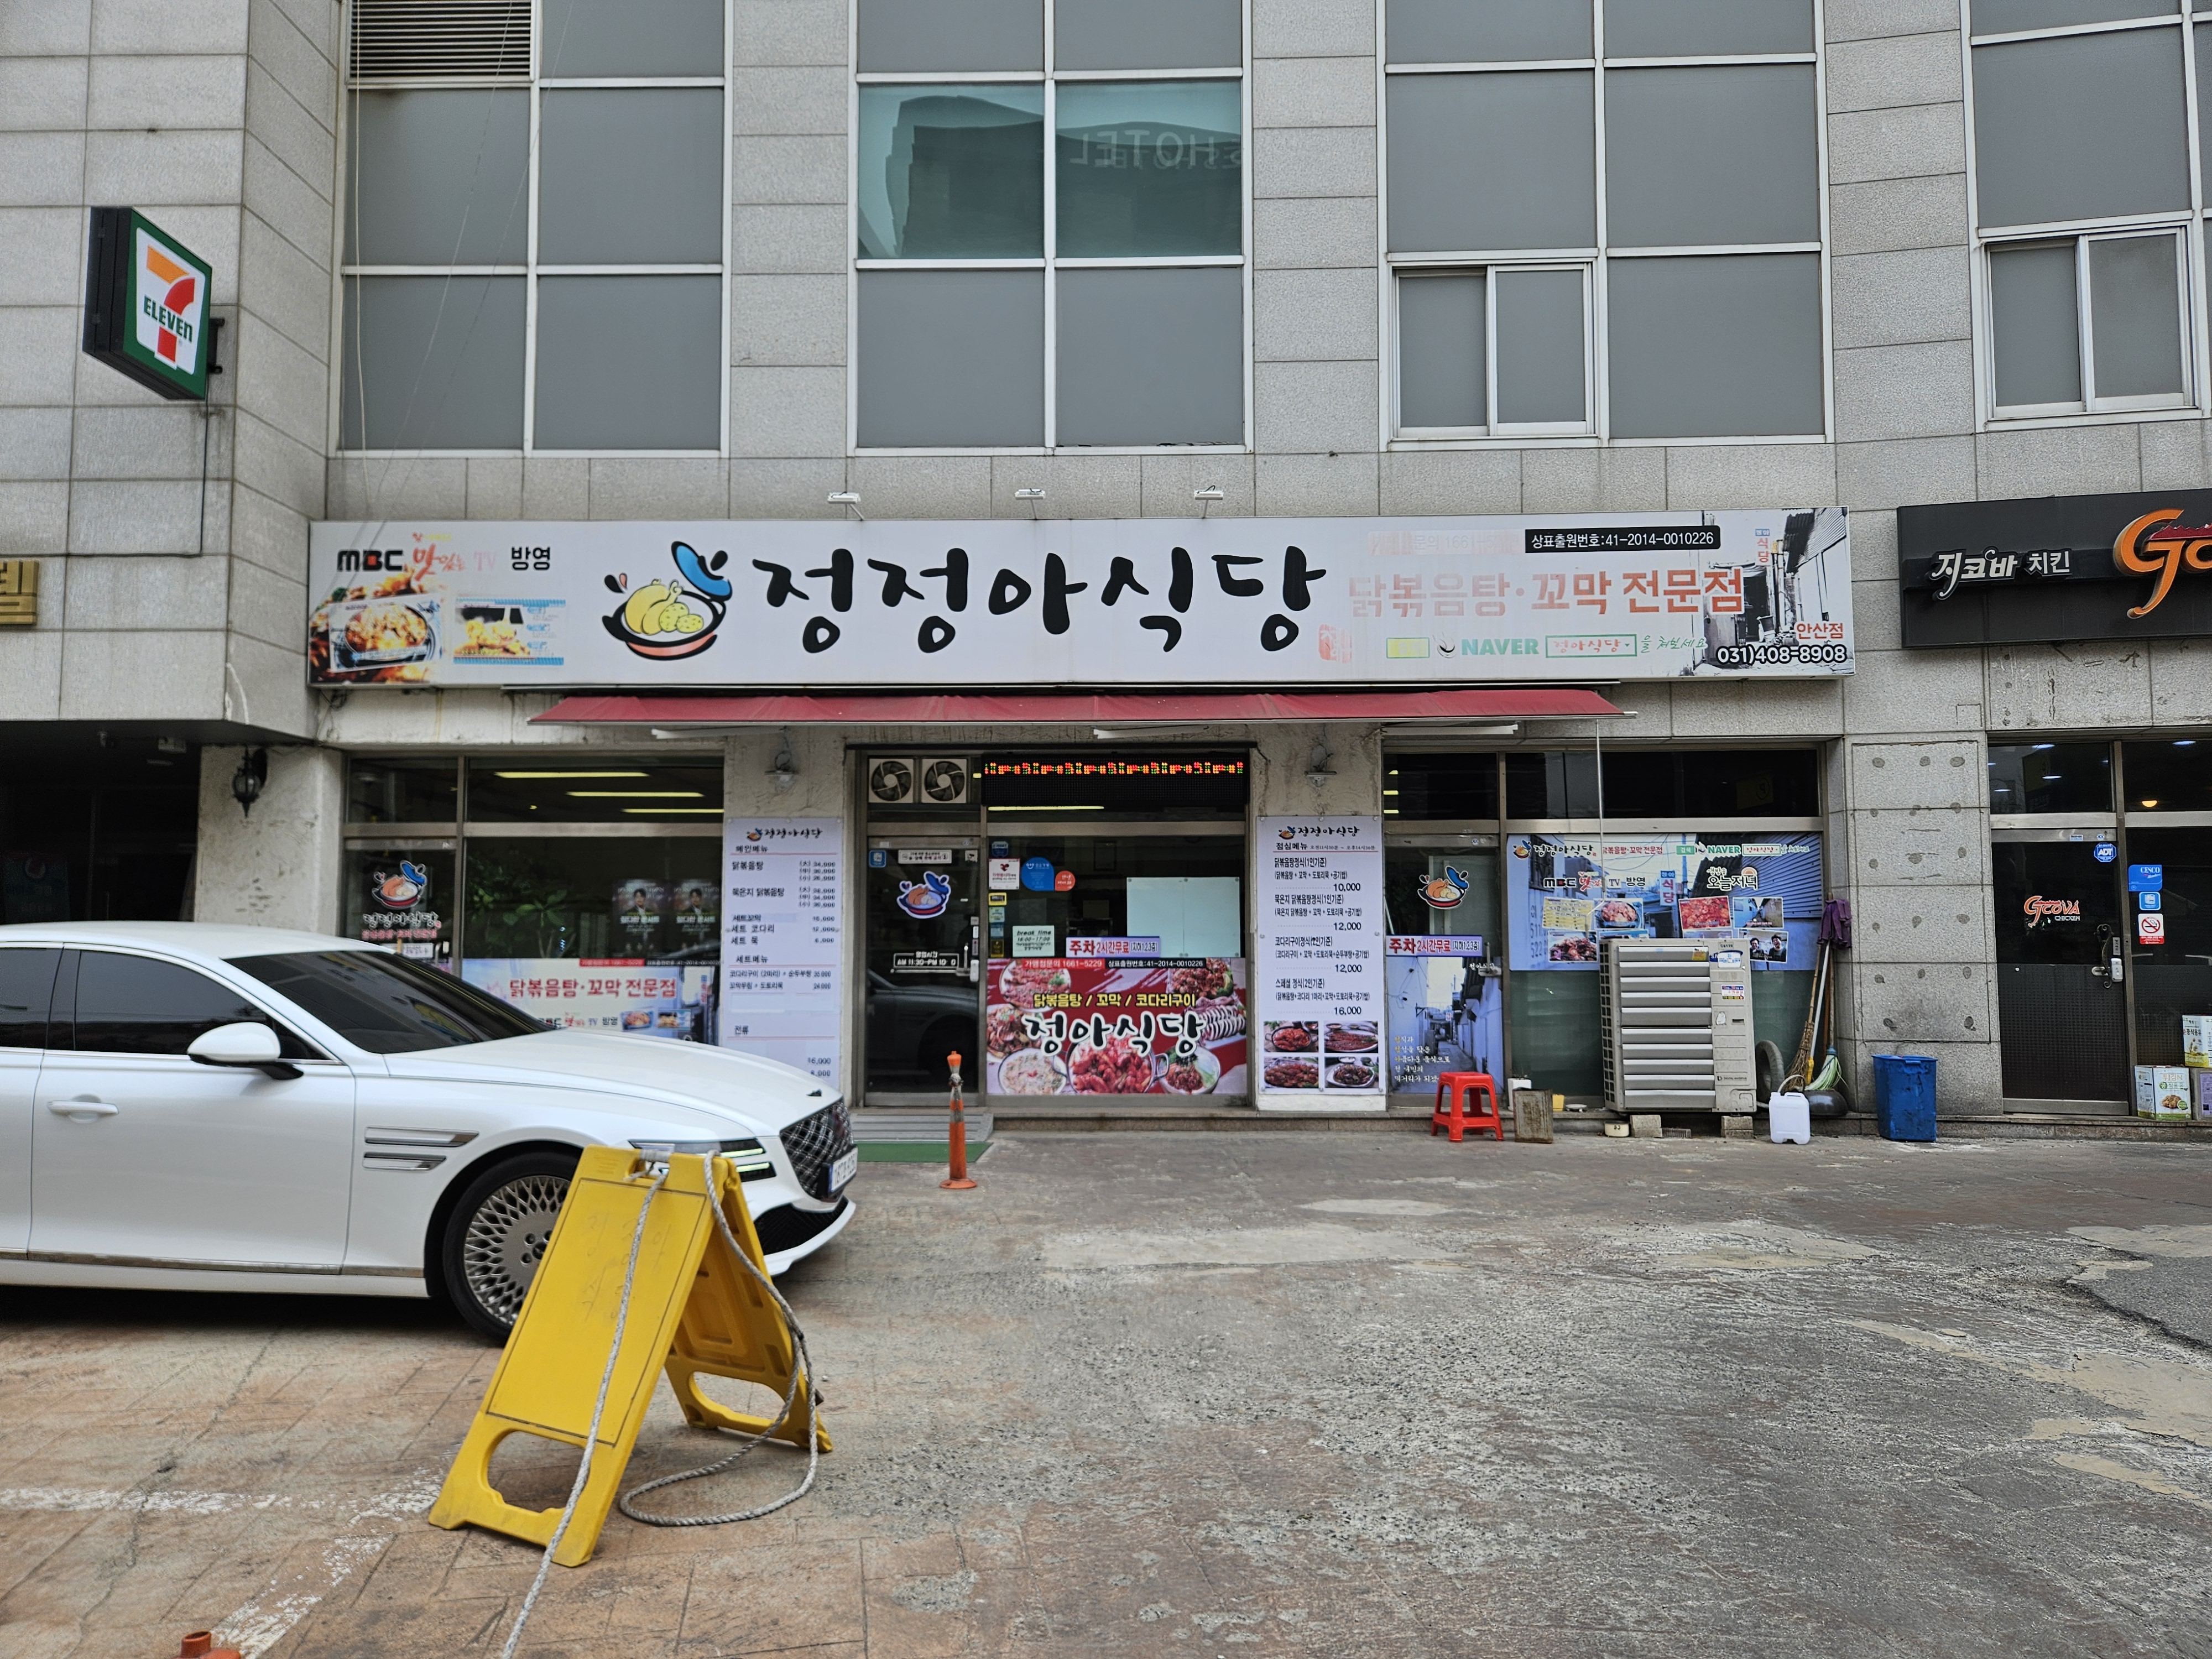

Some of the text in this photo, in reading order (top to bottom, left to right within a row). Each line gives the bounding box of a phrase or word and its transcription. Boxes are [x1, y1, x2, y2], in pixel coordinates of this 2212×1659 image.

[1531, 531, 1714, 548] 상표출원번호:41-2014-0010226
[337, 549, 404, 572] MBC
[511, 545, 551, 571] 방영
[2028, 550, 2071, 576] 치킨
[1622, 569, 1743, 614] 전문점
[752, 545, 1326, 653] 정정아식당
[1797, 623, 1844, 640] 안산점
[1461, 638, 1540, 656] NAVER
[1553, 639, 1621, 653] 정아식당
[1640, 634, 1651, 653] 을
[1717, 645, 1846, 664] 031)408-8908
[764, 827, 823, 839] 정정아식당
[1298, 826, 1360, 837] 정정아식당
[735, 845, 769, 853] 메인메뉴
[1533, 844, 1595, 858] 정정아식당
[1643, 846, 1663, 854] 전문점
[1707, 844, 1741, 854] NAVER
[2098, 848, 2113, 857] ADT
[732, 860, 764, 871] 닭볶음탕
[1274, 857, 1327, 868] 닭볶음탕정식(1인기준)
[2140, 866, 2161, 874] CESCO
[1333, 883, 1361, 892] 10,000
[1543, 877, 1577, 888] MBC
[1609, 878, 1620, 888] TV
[1626, 877, 1646, 887] 방영
[1707, 875, 1759, 891] 오늘저녁
[756, 887, 785, 898] 닭볶음탕
[1661, 879, 1676, 905] 식당
[1274, 894, 1344, 905] 묵은지 닭볶음탕정식(1인기준)
[1290, 908, 1307, 917] 닭볶음탕
[731, 924, 747, 933] 세트
[751, 924, 775, 933] 코다리
[1333, 922, 1361, 931] 12,000
[731, 936, 747, 945] 세트
[1389, 937, 1416, 954] 주차
[1416, 938, 1452, 953] 2시간무료
[1068, 939, 1095, 956] 주차
[1095, 940, 1129, 954] 2시간무료
[735, 954, 769, 963] 세트메뉴
[1062, 959, 1102, 968] 1661-5229
[1334, 964, 1362, 973] 12,000
[509, 978, 622, 999] 닭볶음탕·꼬막
[626, 978, 677, 999] 전문점
[1275, 978, 1325, 989] 스페셜 정식(2인기준)
[1033, 993, 1082, 1008] 닭볶음탕
[1096, 993, 1121, 1007] 꼬막
[1135, 993, 1196, 1007] 코다리구이
[1333, 1006, 1362, 1015] 16,000
[1021, 1010, 1207, 1057] 정아식당
